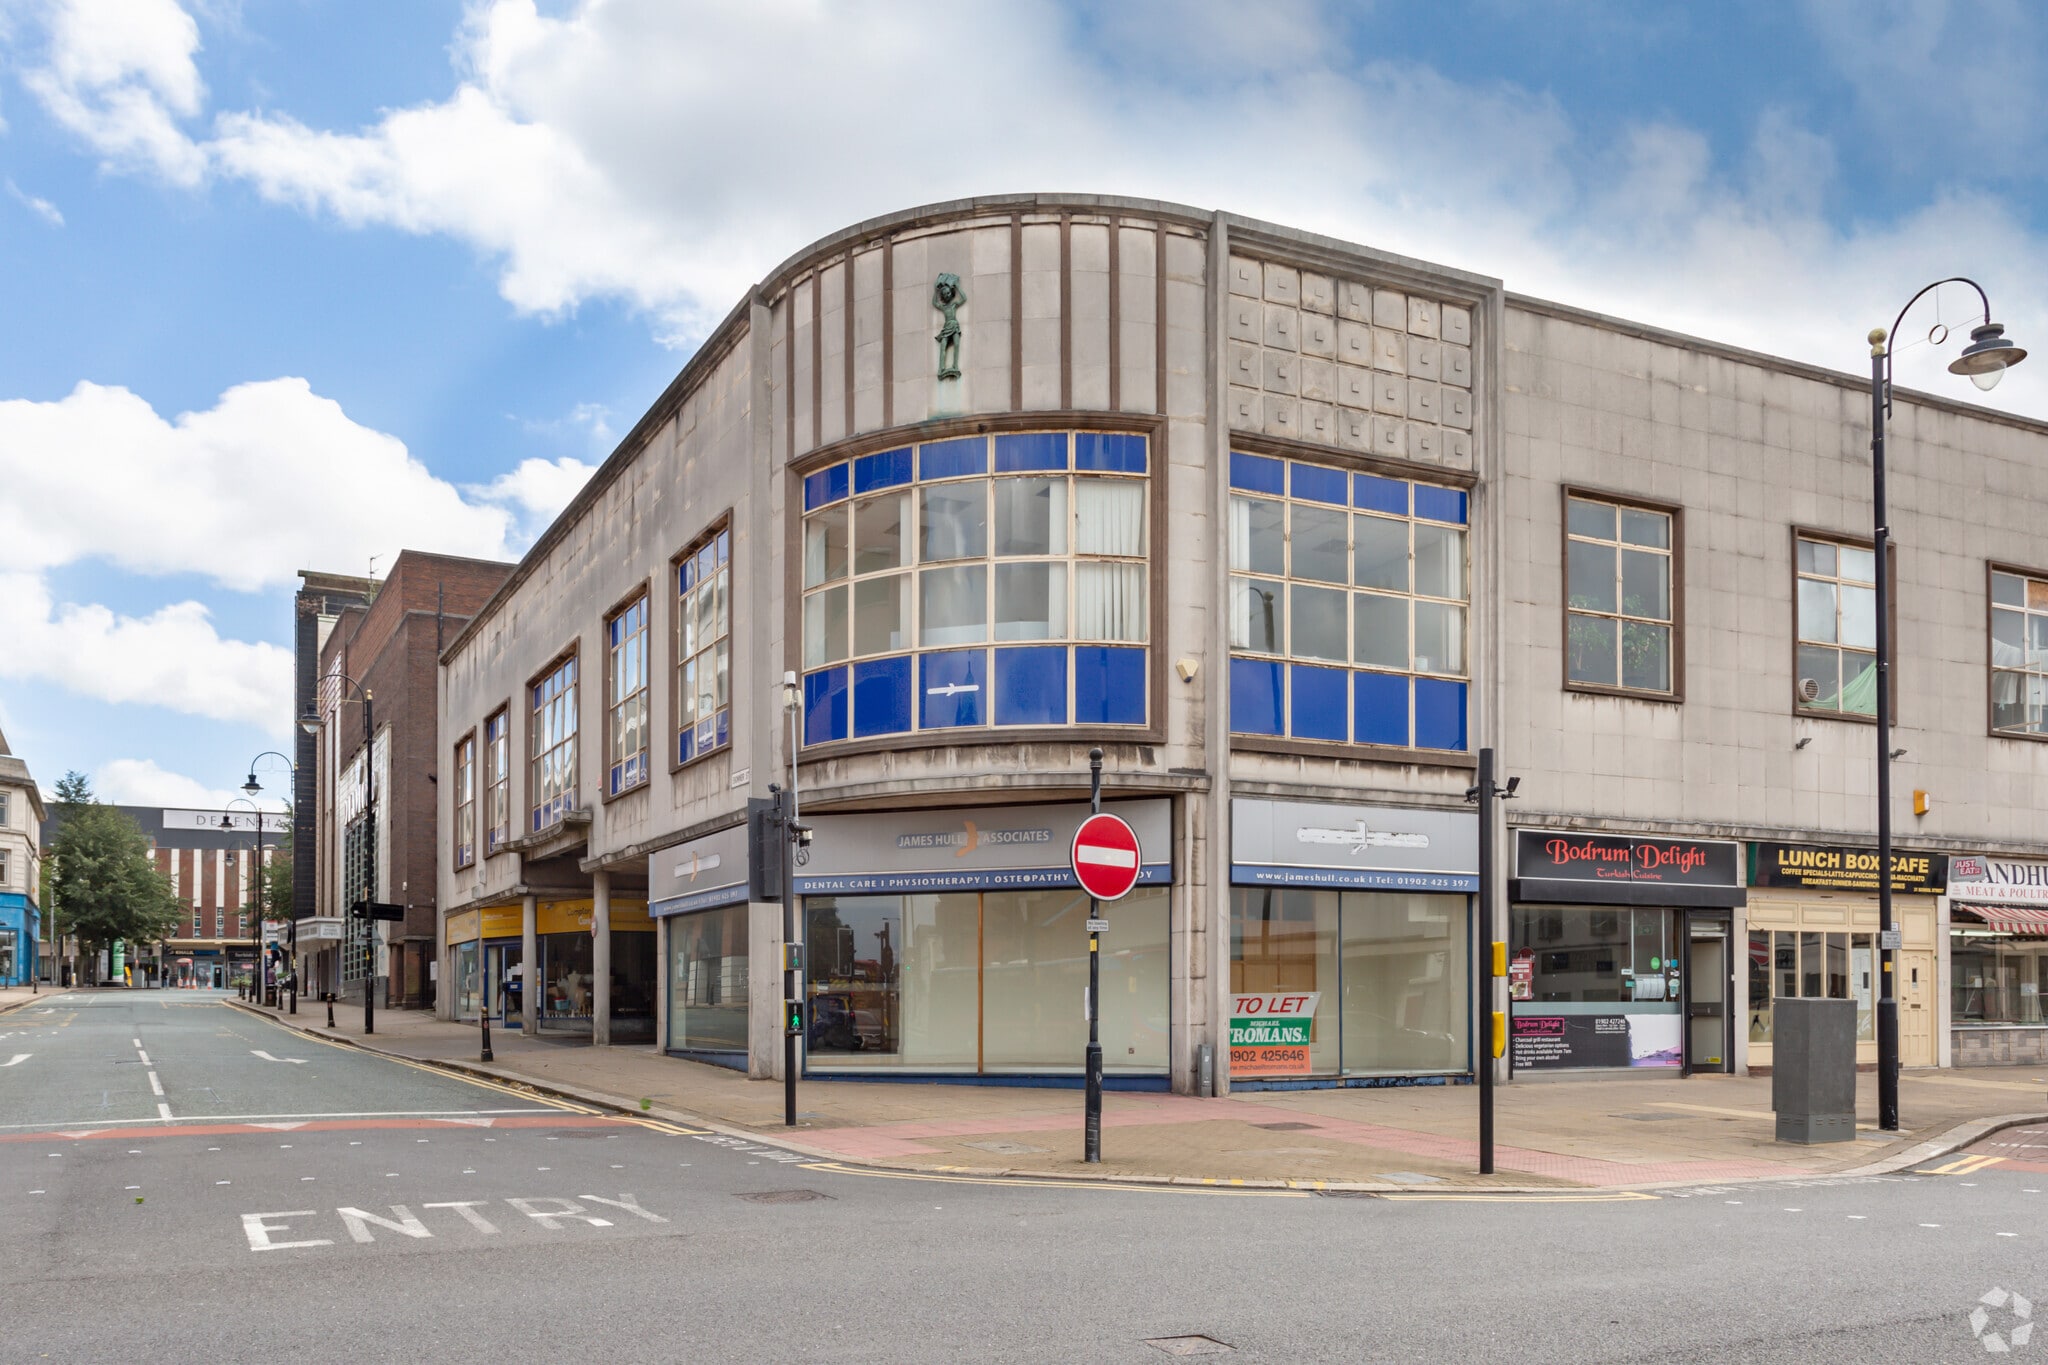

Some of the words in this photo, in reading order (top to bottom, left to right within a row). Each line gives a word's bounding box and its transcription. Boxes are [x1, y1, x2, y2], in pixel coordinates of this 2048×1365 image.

[196, 815, 284, 828] DEENHA
[898, 835, 933, 847] JAMES
[935, 834, 963, 845] HULL
[983, 830, 1049, 843] ASSOCIATES
[1545, 839, 1630, 865] Bodrum
[1636, 844, 1706, 874] Delight
[1778, 849, 1841, 869] LUNCH
[1845, 854, 1880, 871] BOX
[1954, 860, 1975, 869] JUST
[1595, 867, 1631, 879] Turkish
[1633, 869, 1662, 880] Cuisine
[1781, 867, 1802, 876] COFFEE
[1960, 867, 1975, 875] EAT
[804, 881, 845, 889] DENTAL
[849, 880, 877, 888] CARE
[889, 876, 981, 887] PHYSIOTHERAPY
[994, 873, 1069, 883] OSTEOPATHY
[1256, 871, 1366, 884] www.jameshull.co.uk
[1376, 876, 1393, 885] Tel:
[1397, 877, 1427, 886] 01902
[1430, 878, 1448, 886] 425
[1452, 879, 1469, 888] 397
[1965, 885, 1996, 897] MEAT
[1998, 888, 2006, 898] &
[1235, 997, 1263, 1014] TO
[1267, 996, 1309, 1014] LET
[1230, 1027, 1303, 1043] ROMANS
[1260, 1050, 1305, 1062] 425646
[240, 1193, 671, 1252] ENTRY
